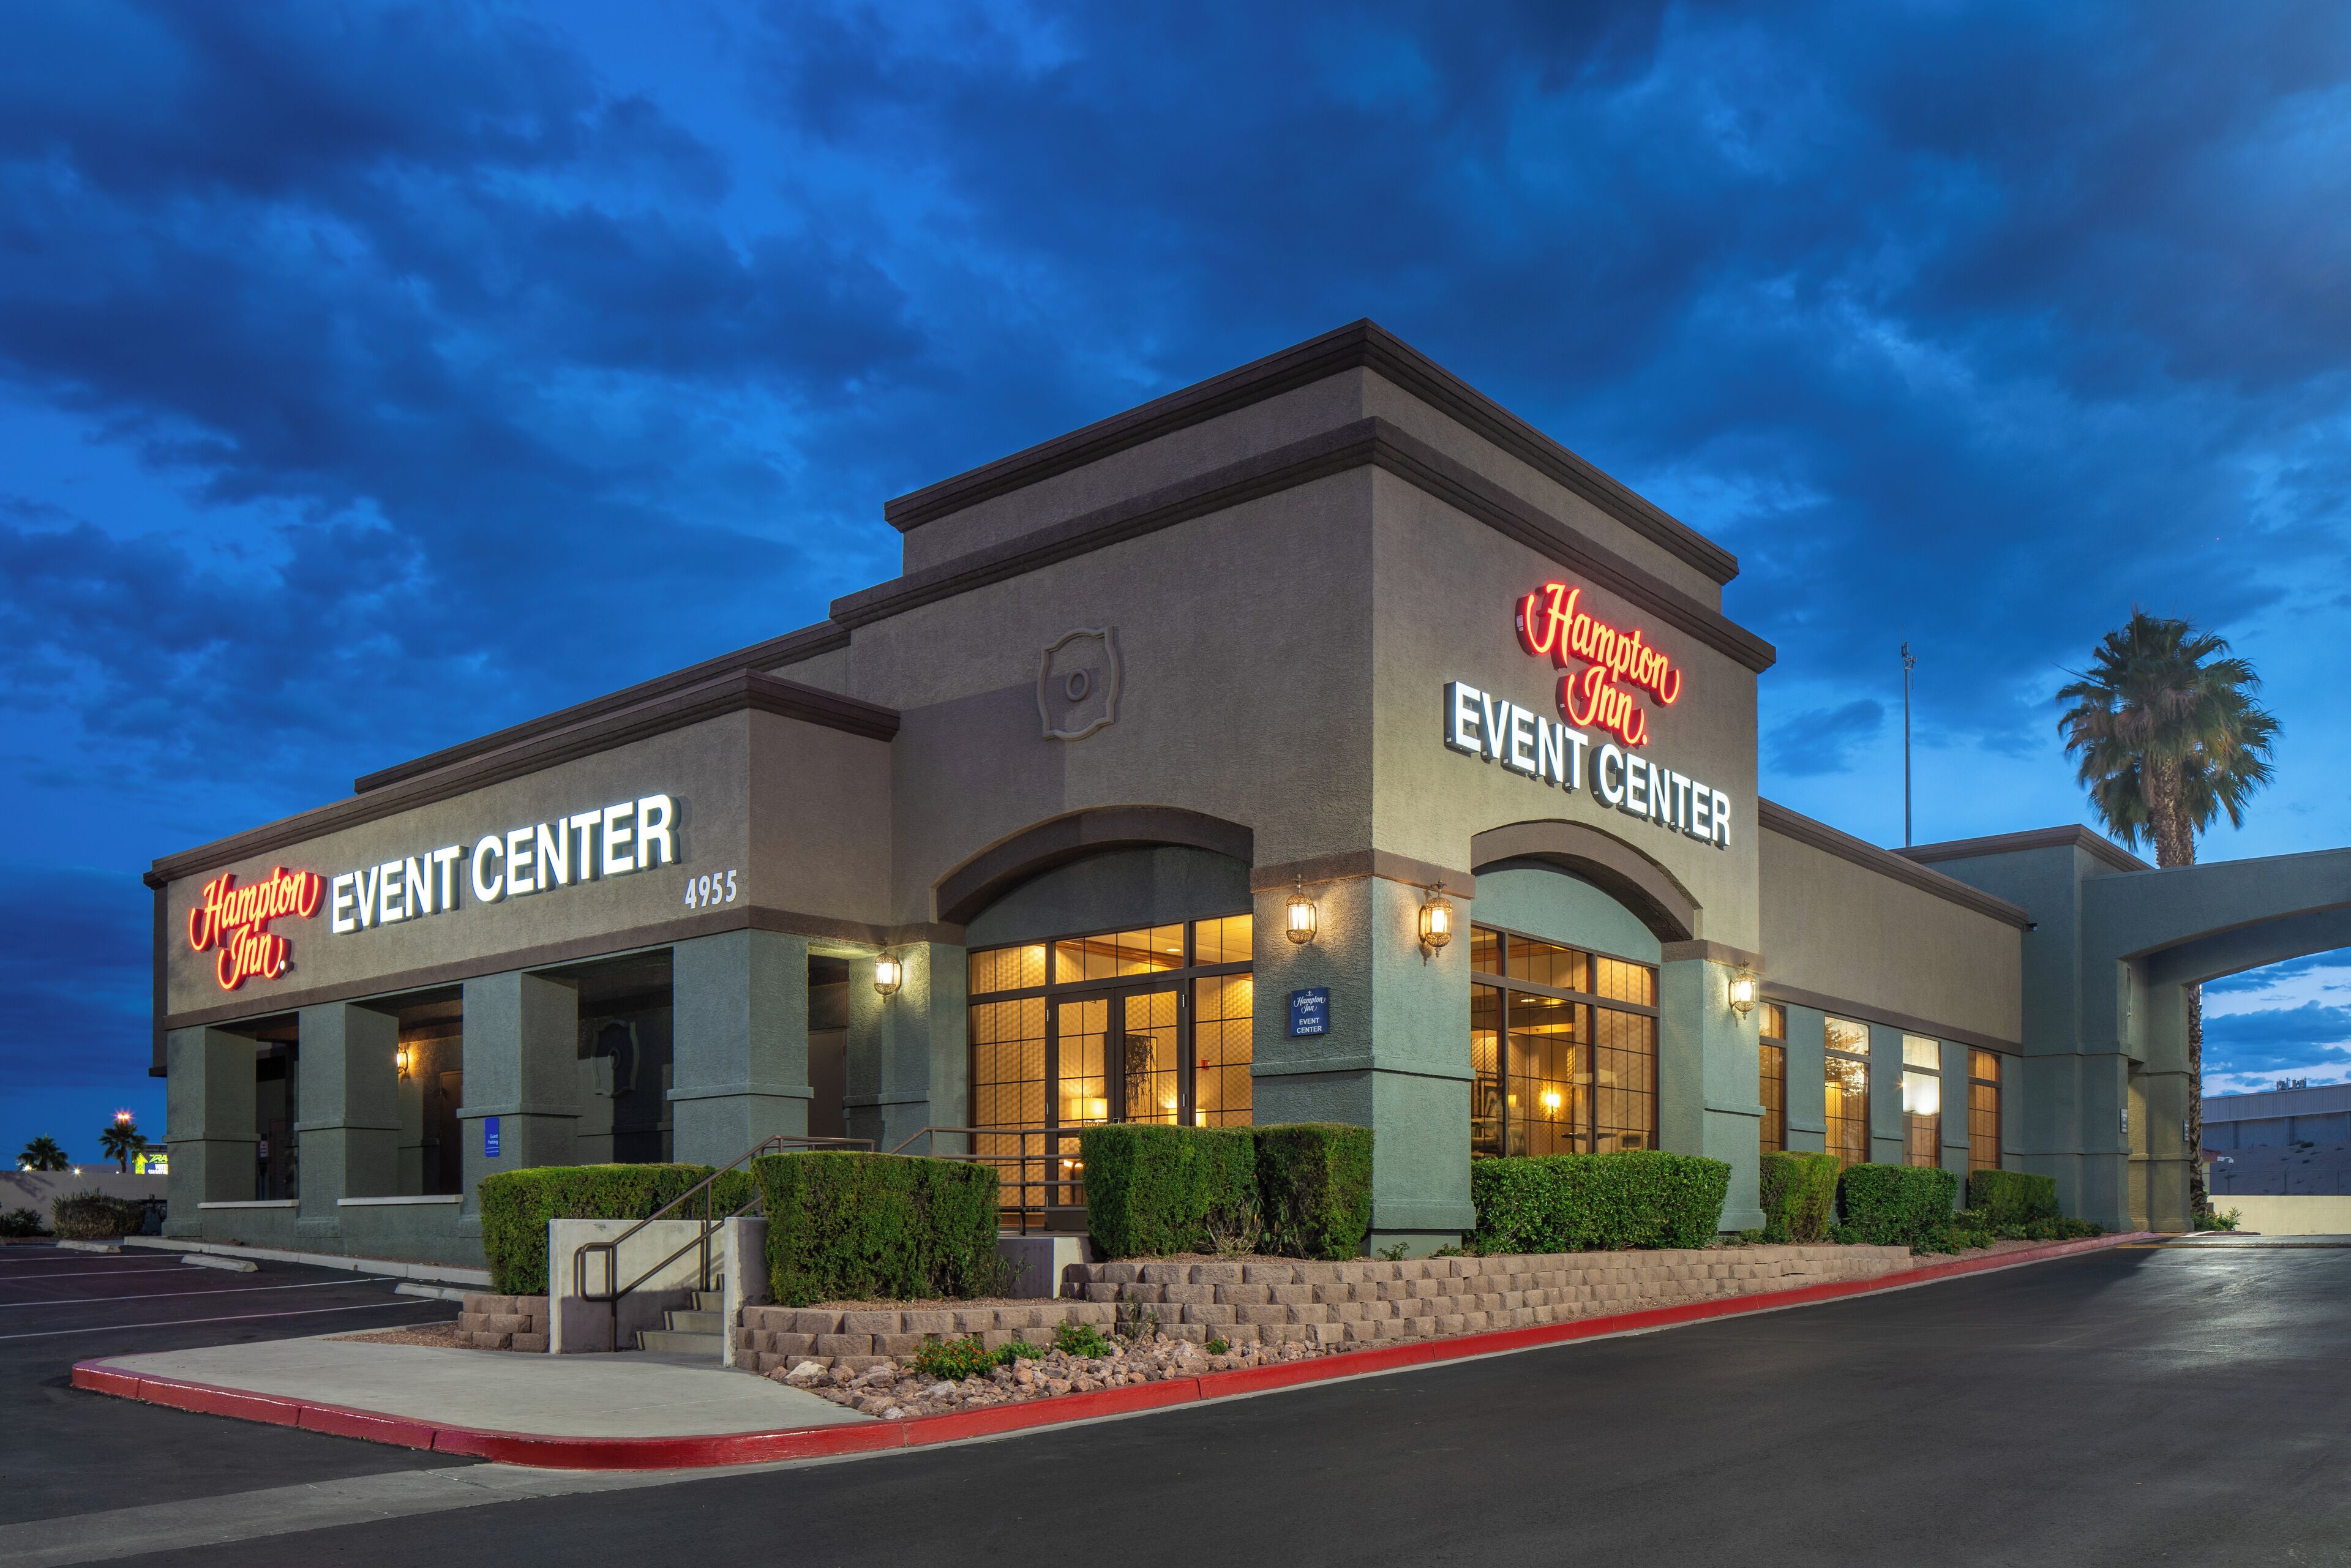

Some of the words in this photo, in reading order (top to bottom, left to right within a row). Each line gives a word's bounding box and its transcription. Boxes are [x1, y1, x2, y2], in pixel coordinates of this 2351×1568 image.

[1526, 583, 1680, 703] Hampton
[1455, 681, 1588, 790] EVENT
[1599, 743, 1731, 846] CENTER
[331, 845, 461, 934] EVENT
[471, 794, 674, 902] CENTER
[684, 870, 737, 909] 4955
[189, 866, 319, 950] Hampton
[1293, 996, 1326, 1007] Hampton
[1301, 1004, 1317, 1014] Inn
